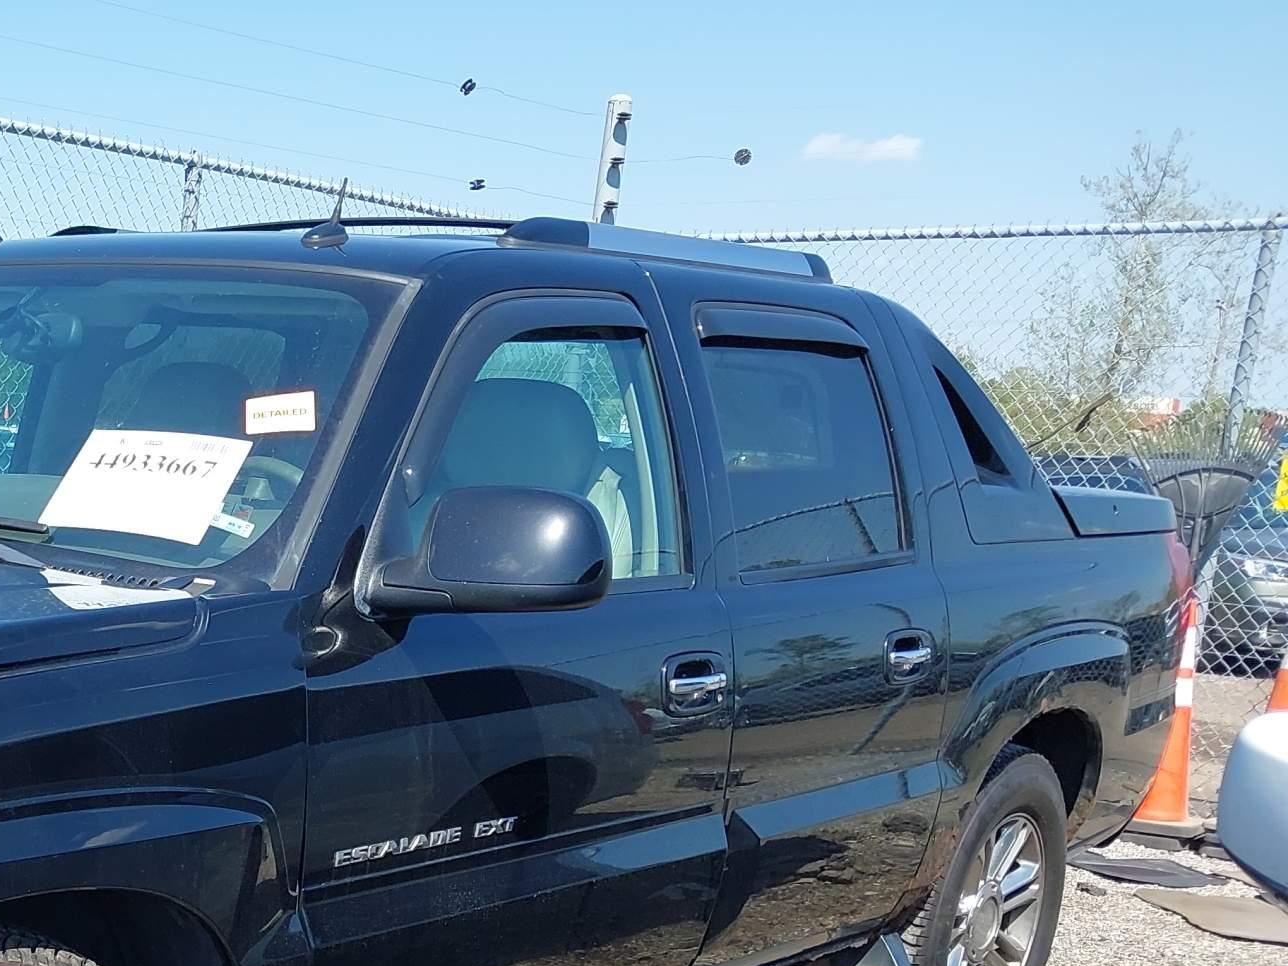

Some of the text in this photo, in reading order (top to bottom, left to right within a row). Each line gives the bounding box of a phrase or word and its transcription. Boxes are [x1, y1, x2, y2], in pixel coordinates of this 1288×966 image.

[253, 407, 308, 421] DETAILED
[89, 452, 219, 479] 44933667
[334, 816, 518, 868] ESCALADE EXT
